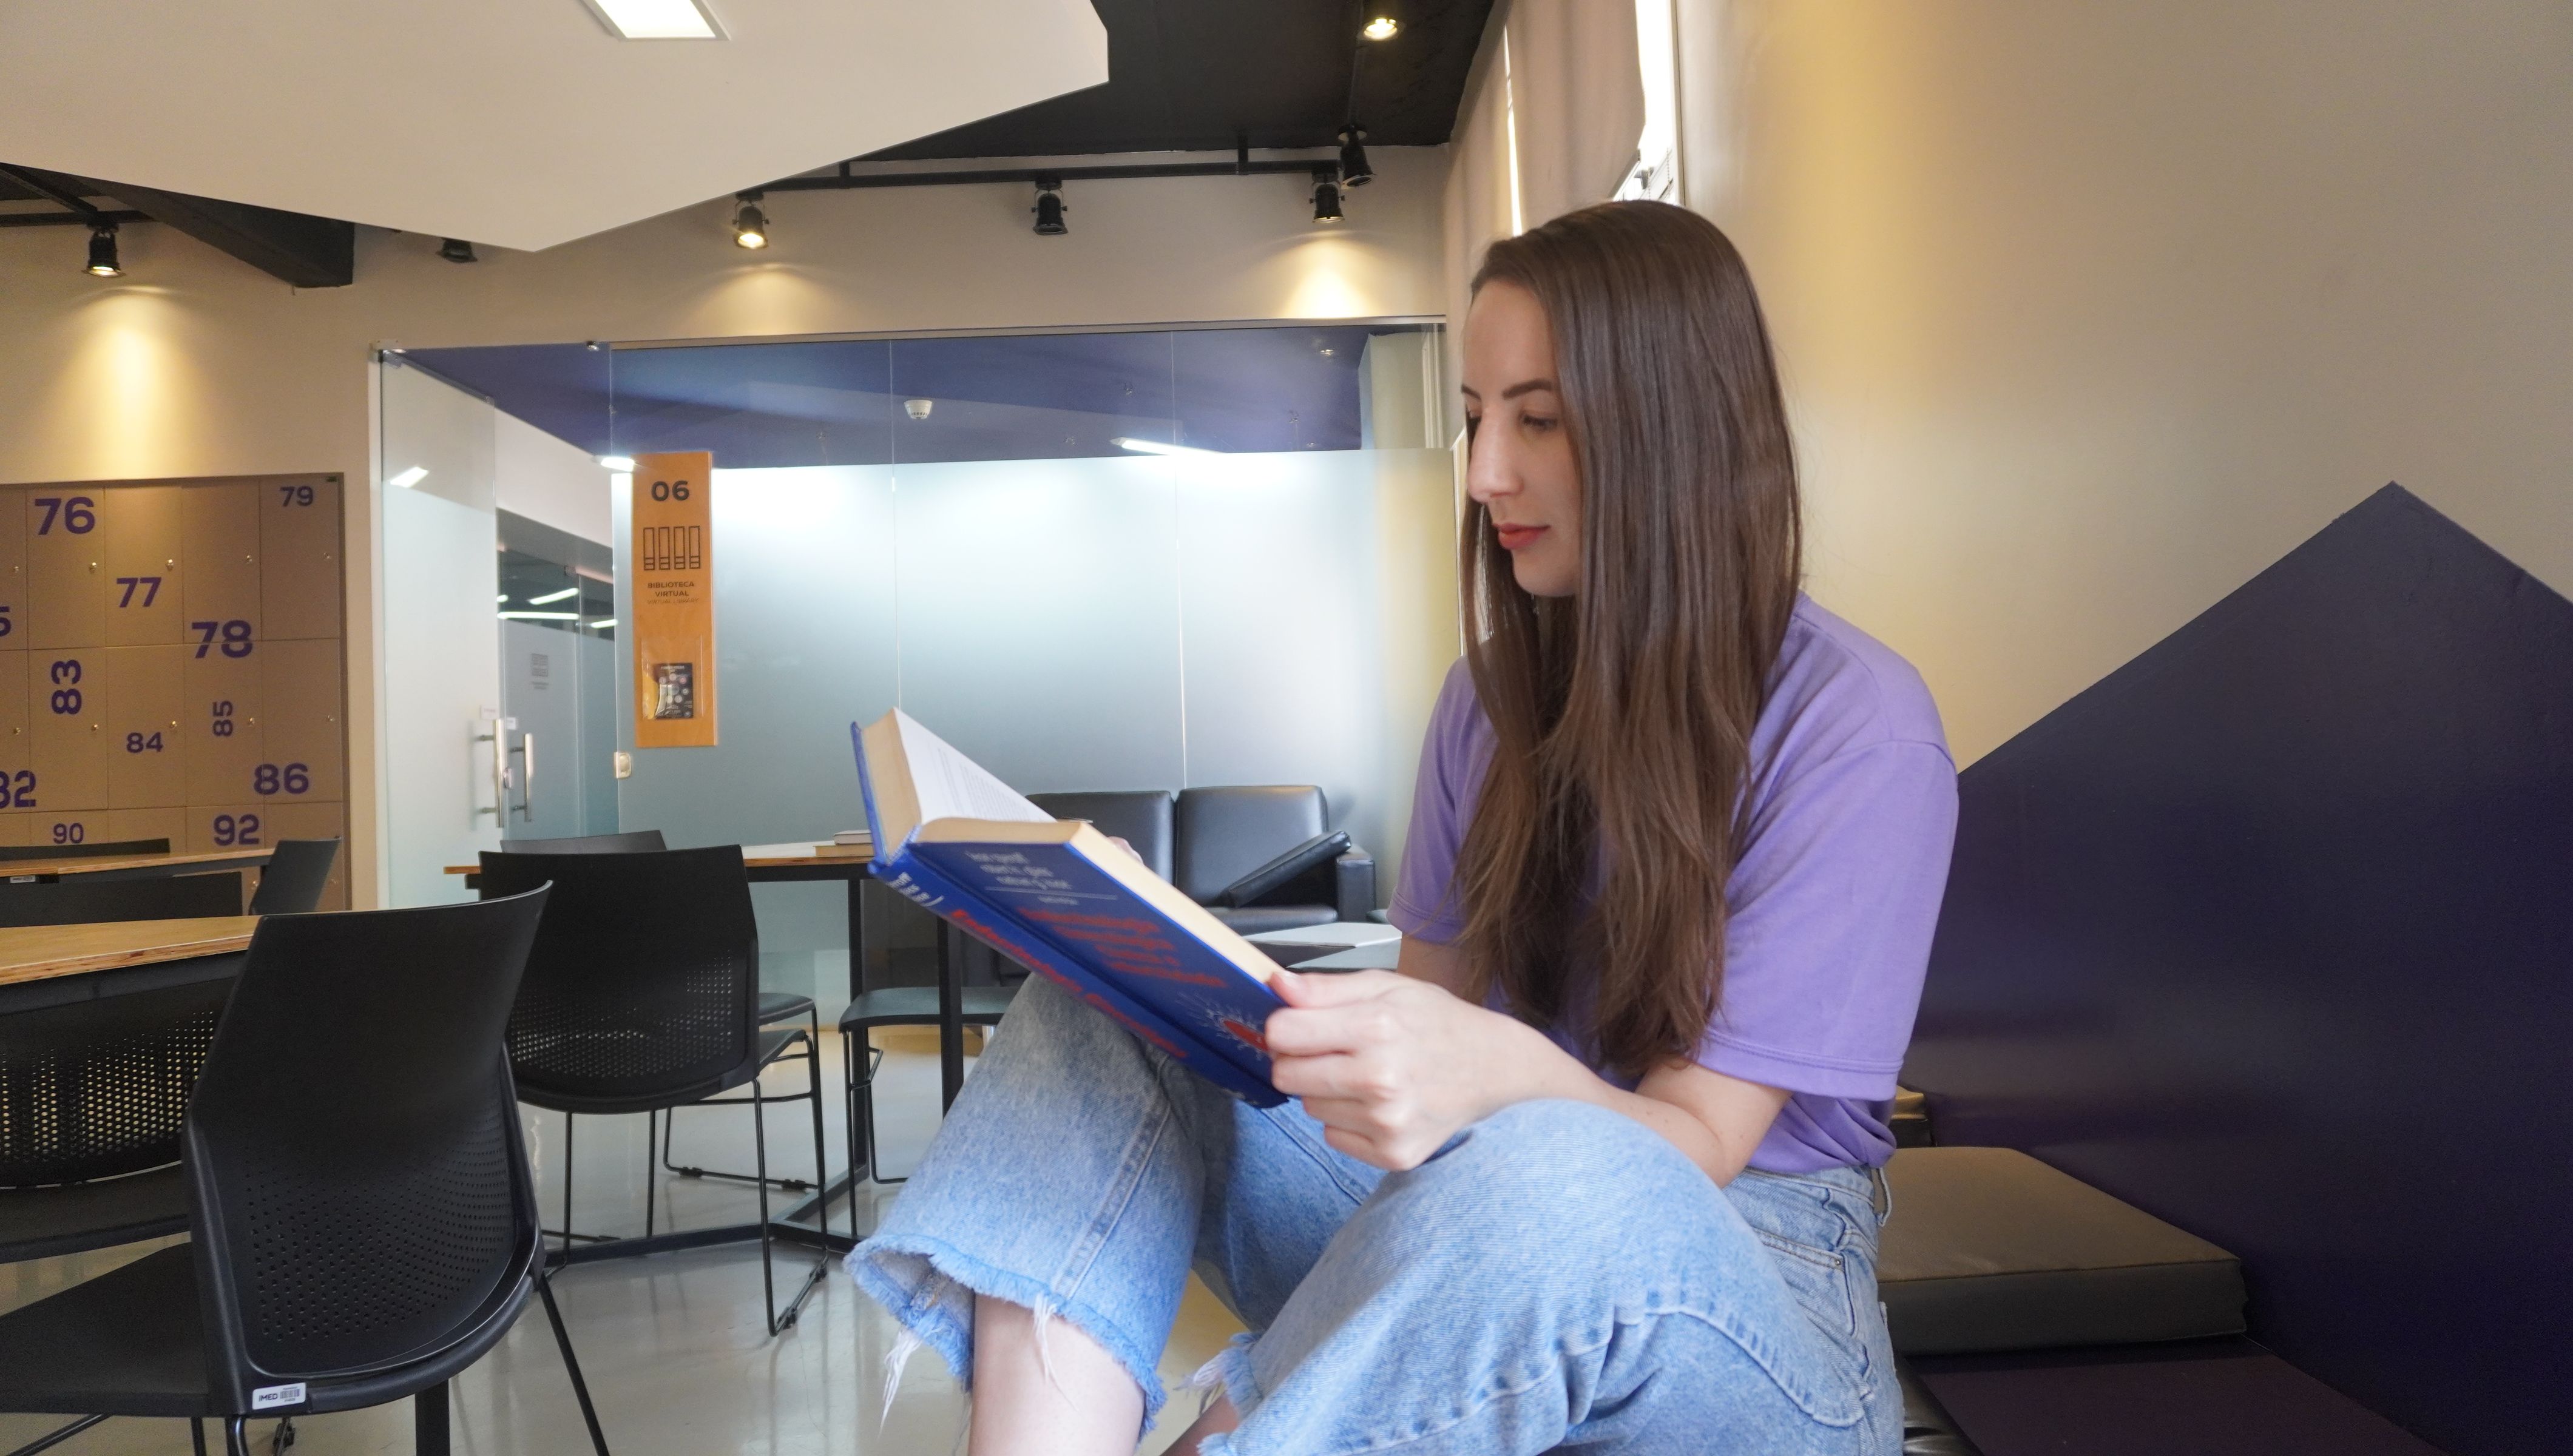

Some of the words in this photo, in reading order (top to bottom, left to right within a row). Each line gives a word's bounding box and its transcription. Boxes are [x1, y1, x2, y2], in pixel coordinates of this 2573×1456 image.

[280, 486, 313, 507] 79
[651, 480, 689, 501] 06
[34, 497, 95, 535] 76
[117, 577, 161, 608] 77
[192, 620, 252, 658] 78
[51, 660, 81, 715] 83
[213, 701, 233, 736] 85
[127, 732, 163, 753] 84
[254, 763, 309, 795] 86
[53, 823, 84, 844] 90
[214, 814, 259, 846] 92
